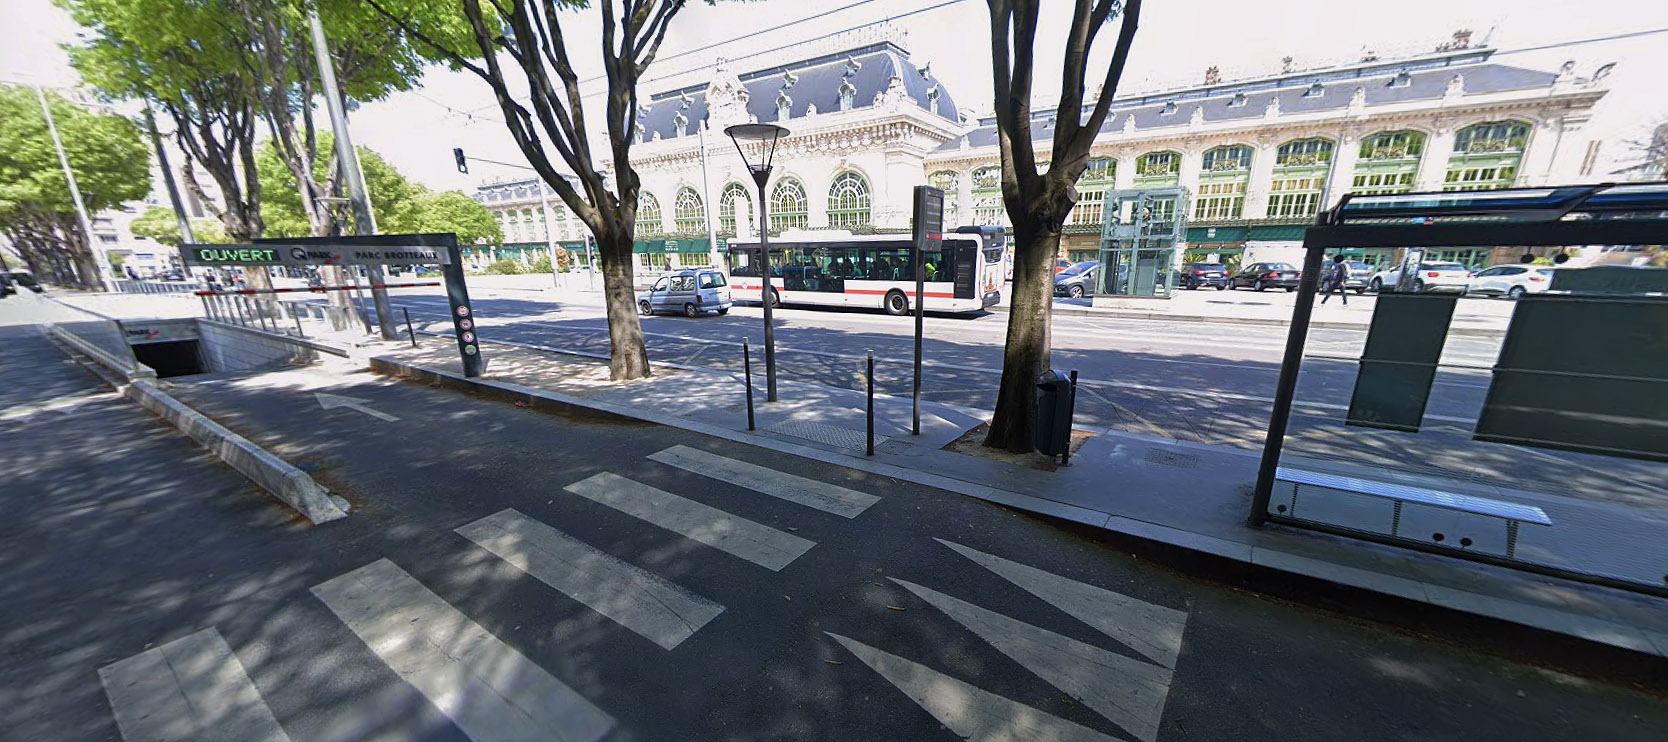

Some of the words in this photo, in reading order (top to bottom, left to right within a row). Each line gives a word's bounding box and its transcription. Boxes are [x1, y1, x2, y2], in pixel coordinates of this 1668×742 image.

[200, 249, 274, 261] OUVERT
[355, 252, 380, 260] PARC
[385, 251, 438, 260] BROTTEAUX
